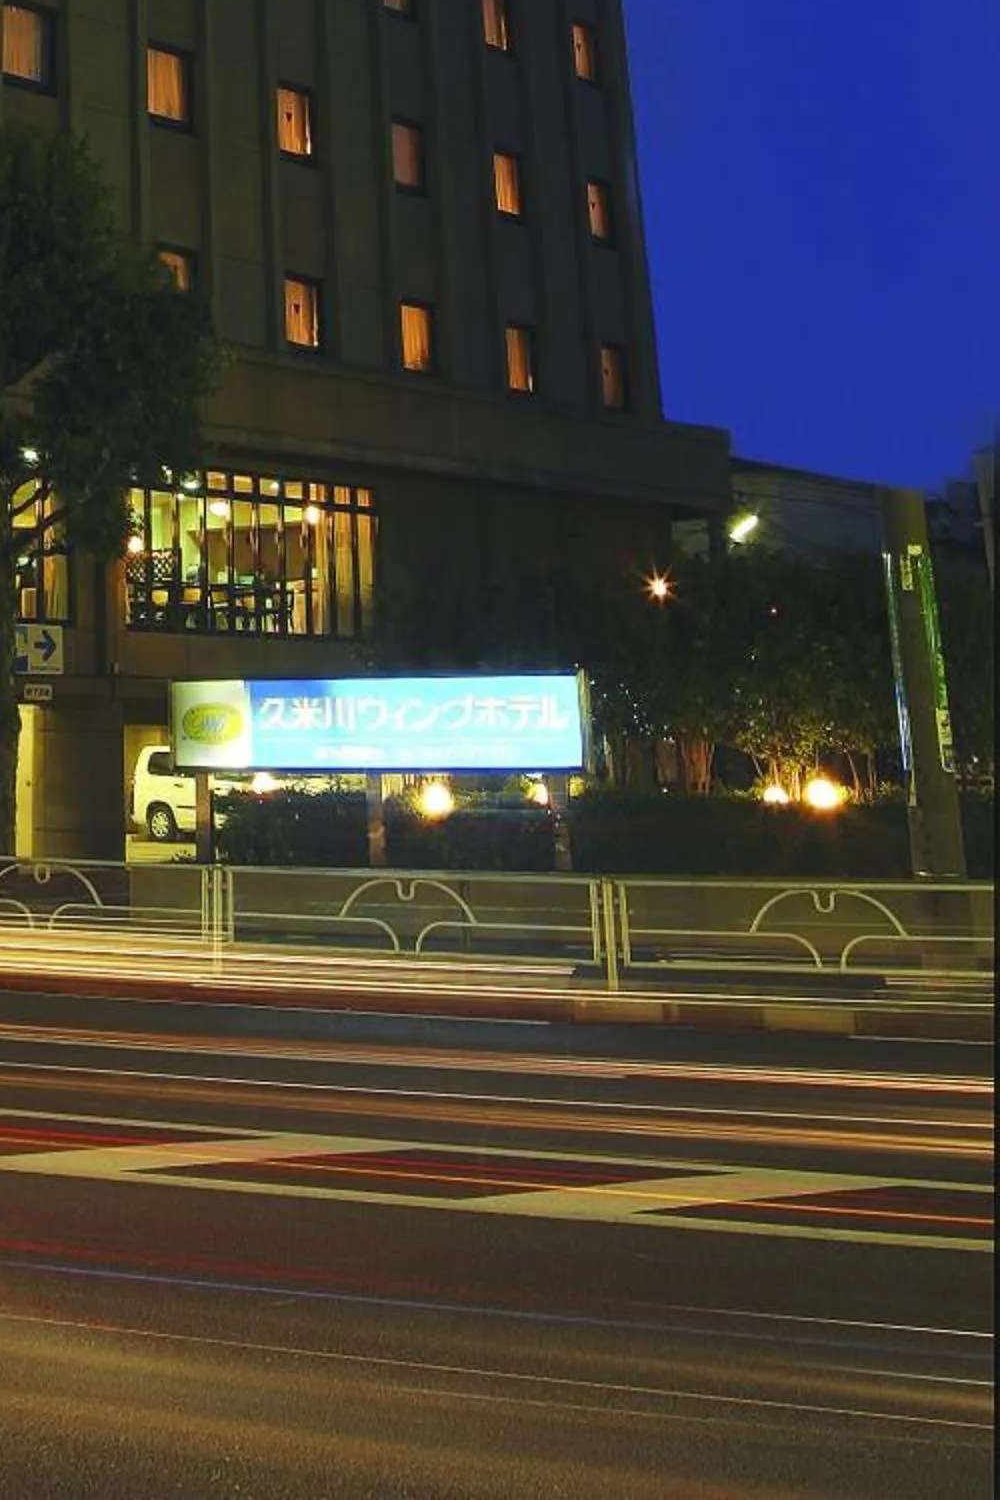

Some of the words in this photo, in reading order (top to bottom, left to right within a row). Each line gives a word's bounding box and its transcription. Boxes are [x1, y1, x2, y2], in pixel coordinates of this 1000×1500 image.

[258, 694, 571, 734] 久米川ウィングホテル
